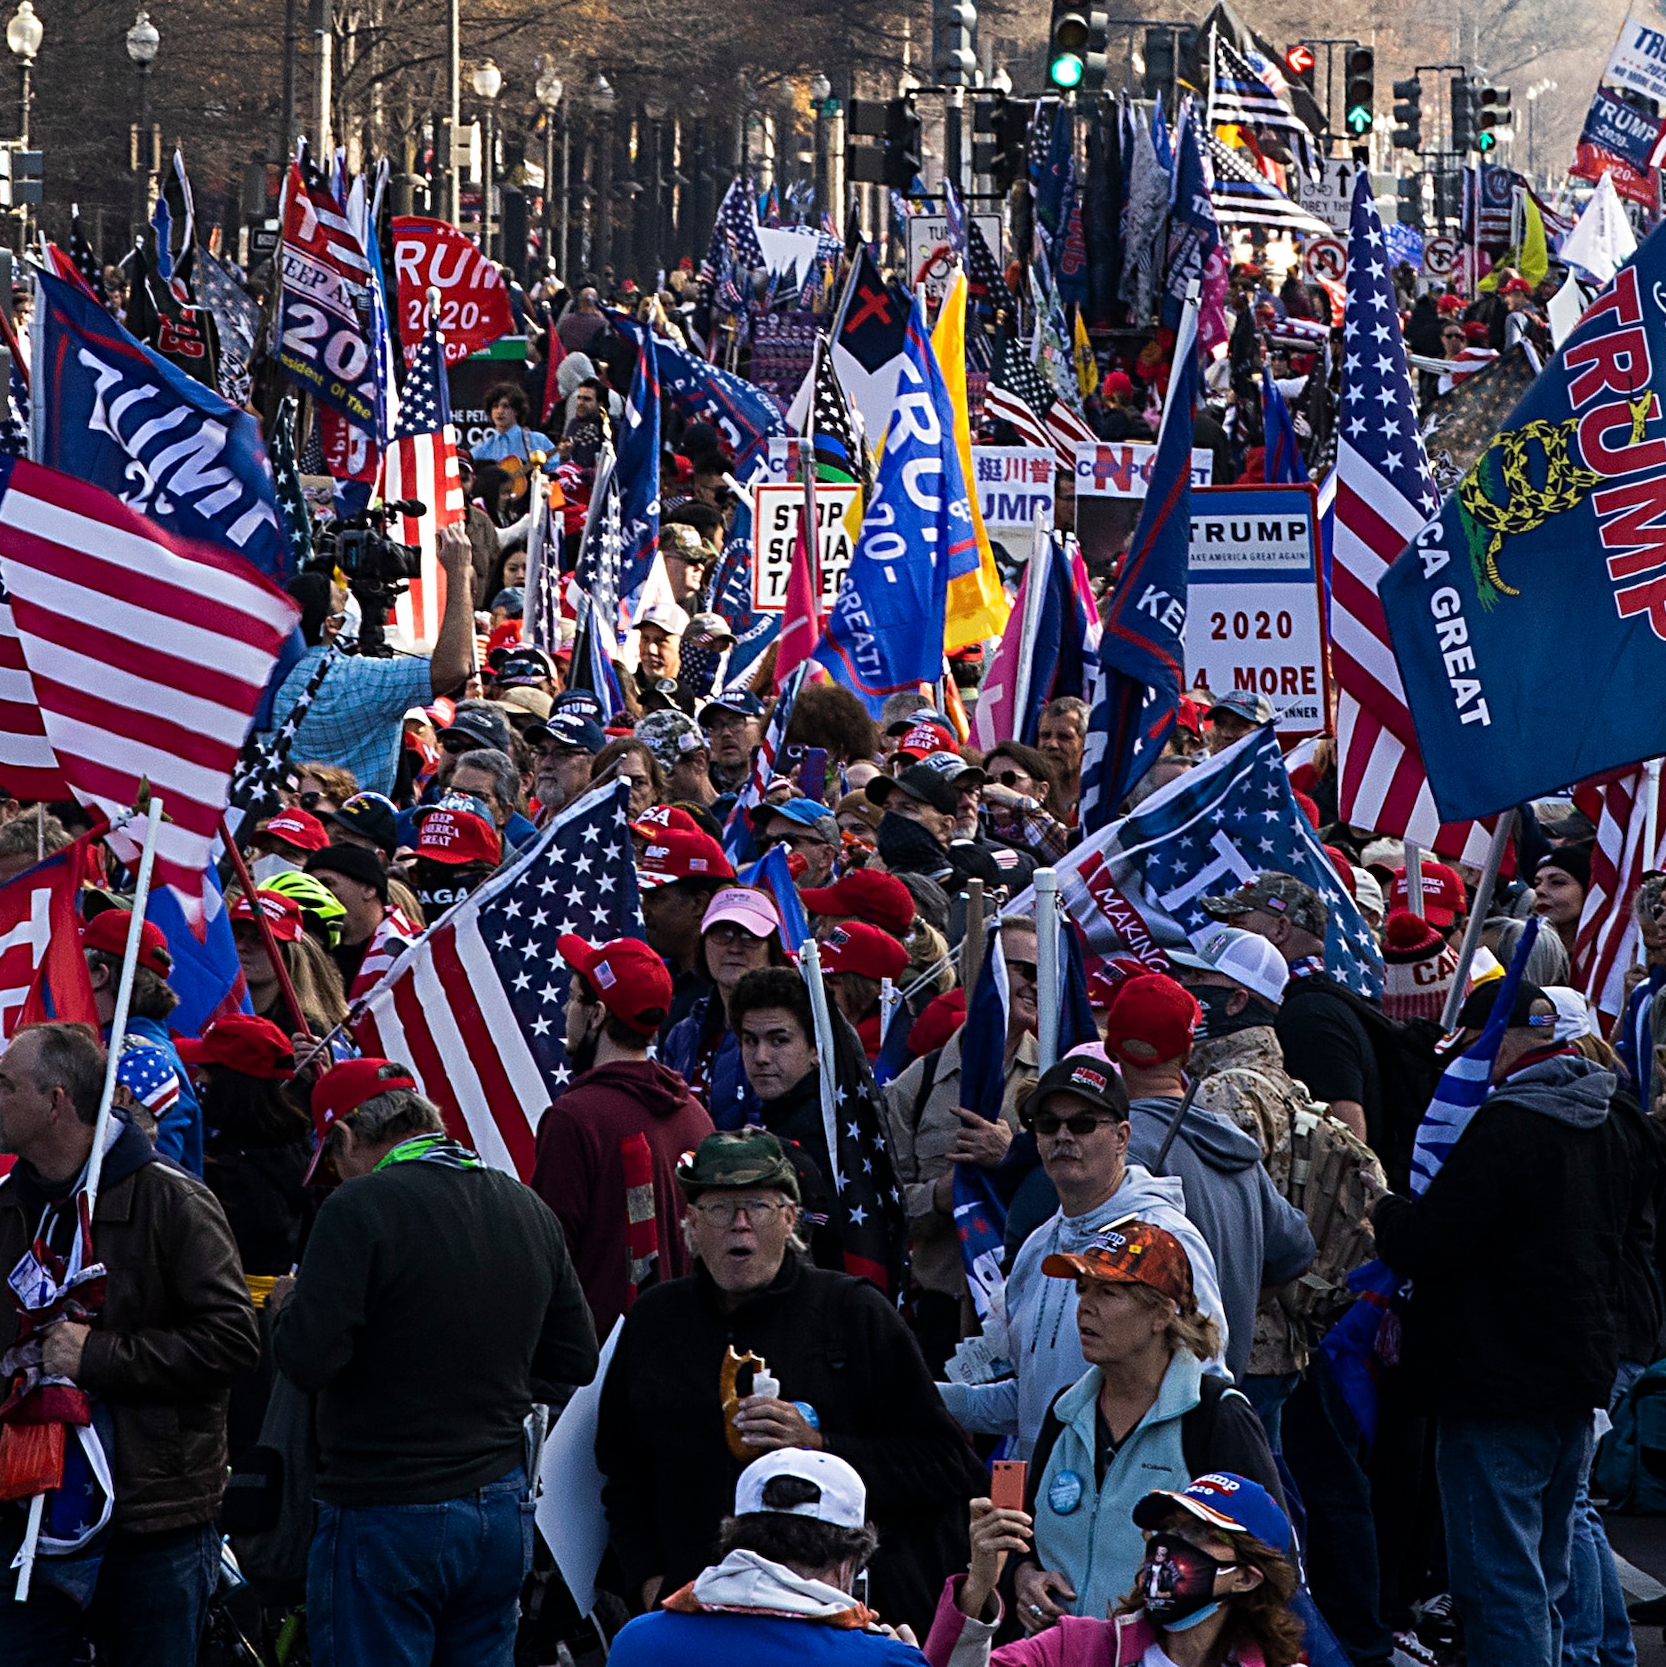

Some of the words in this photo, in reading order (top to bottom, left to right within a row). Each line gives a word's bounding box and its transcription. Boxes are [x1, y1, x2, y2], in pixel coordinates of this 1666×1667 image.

[283, 258, 329, 290] EEP
[1190, 552, 1207, 562] AKE
[1209, 552, 1247, 562] AMERICA
[1250, 552, 1276, 561] GREAT
[1211, 611, 1293, 640] 2020
[1431, 584, 1492, 729] GREAT
[1234, 666, 1317, 695] MORE
[428, 813, 455, 824] KEEP
[421, 824, 460, 839] AMERICA
[421, 836, 452, 848] GREAT
